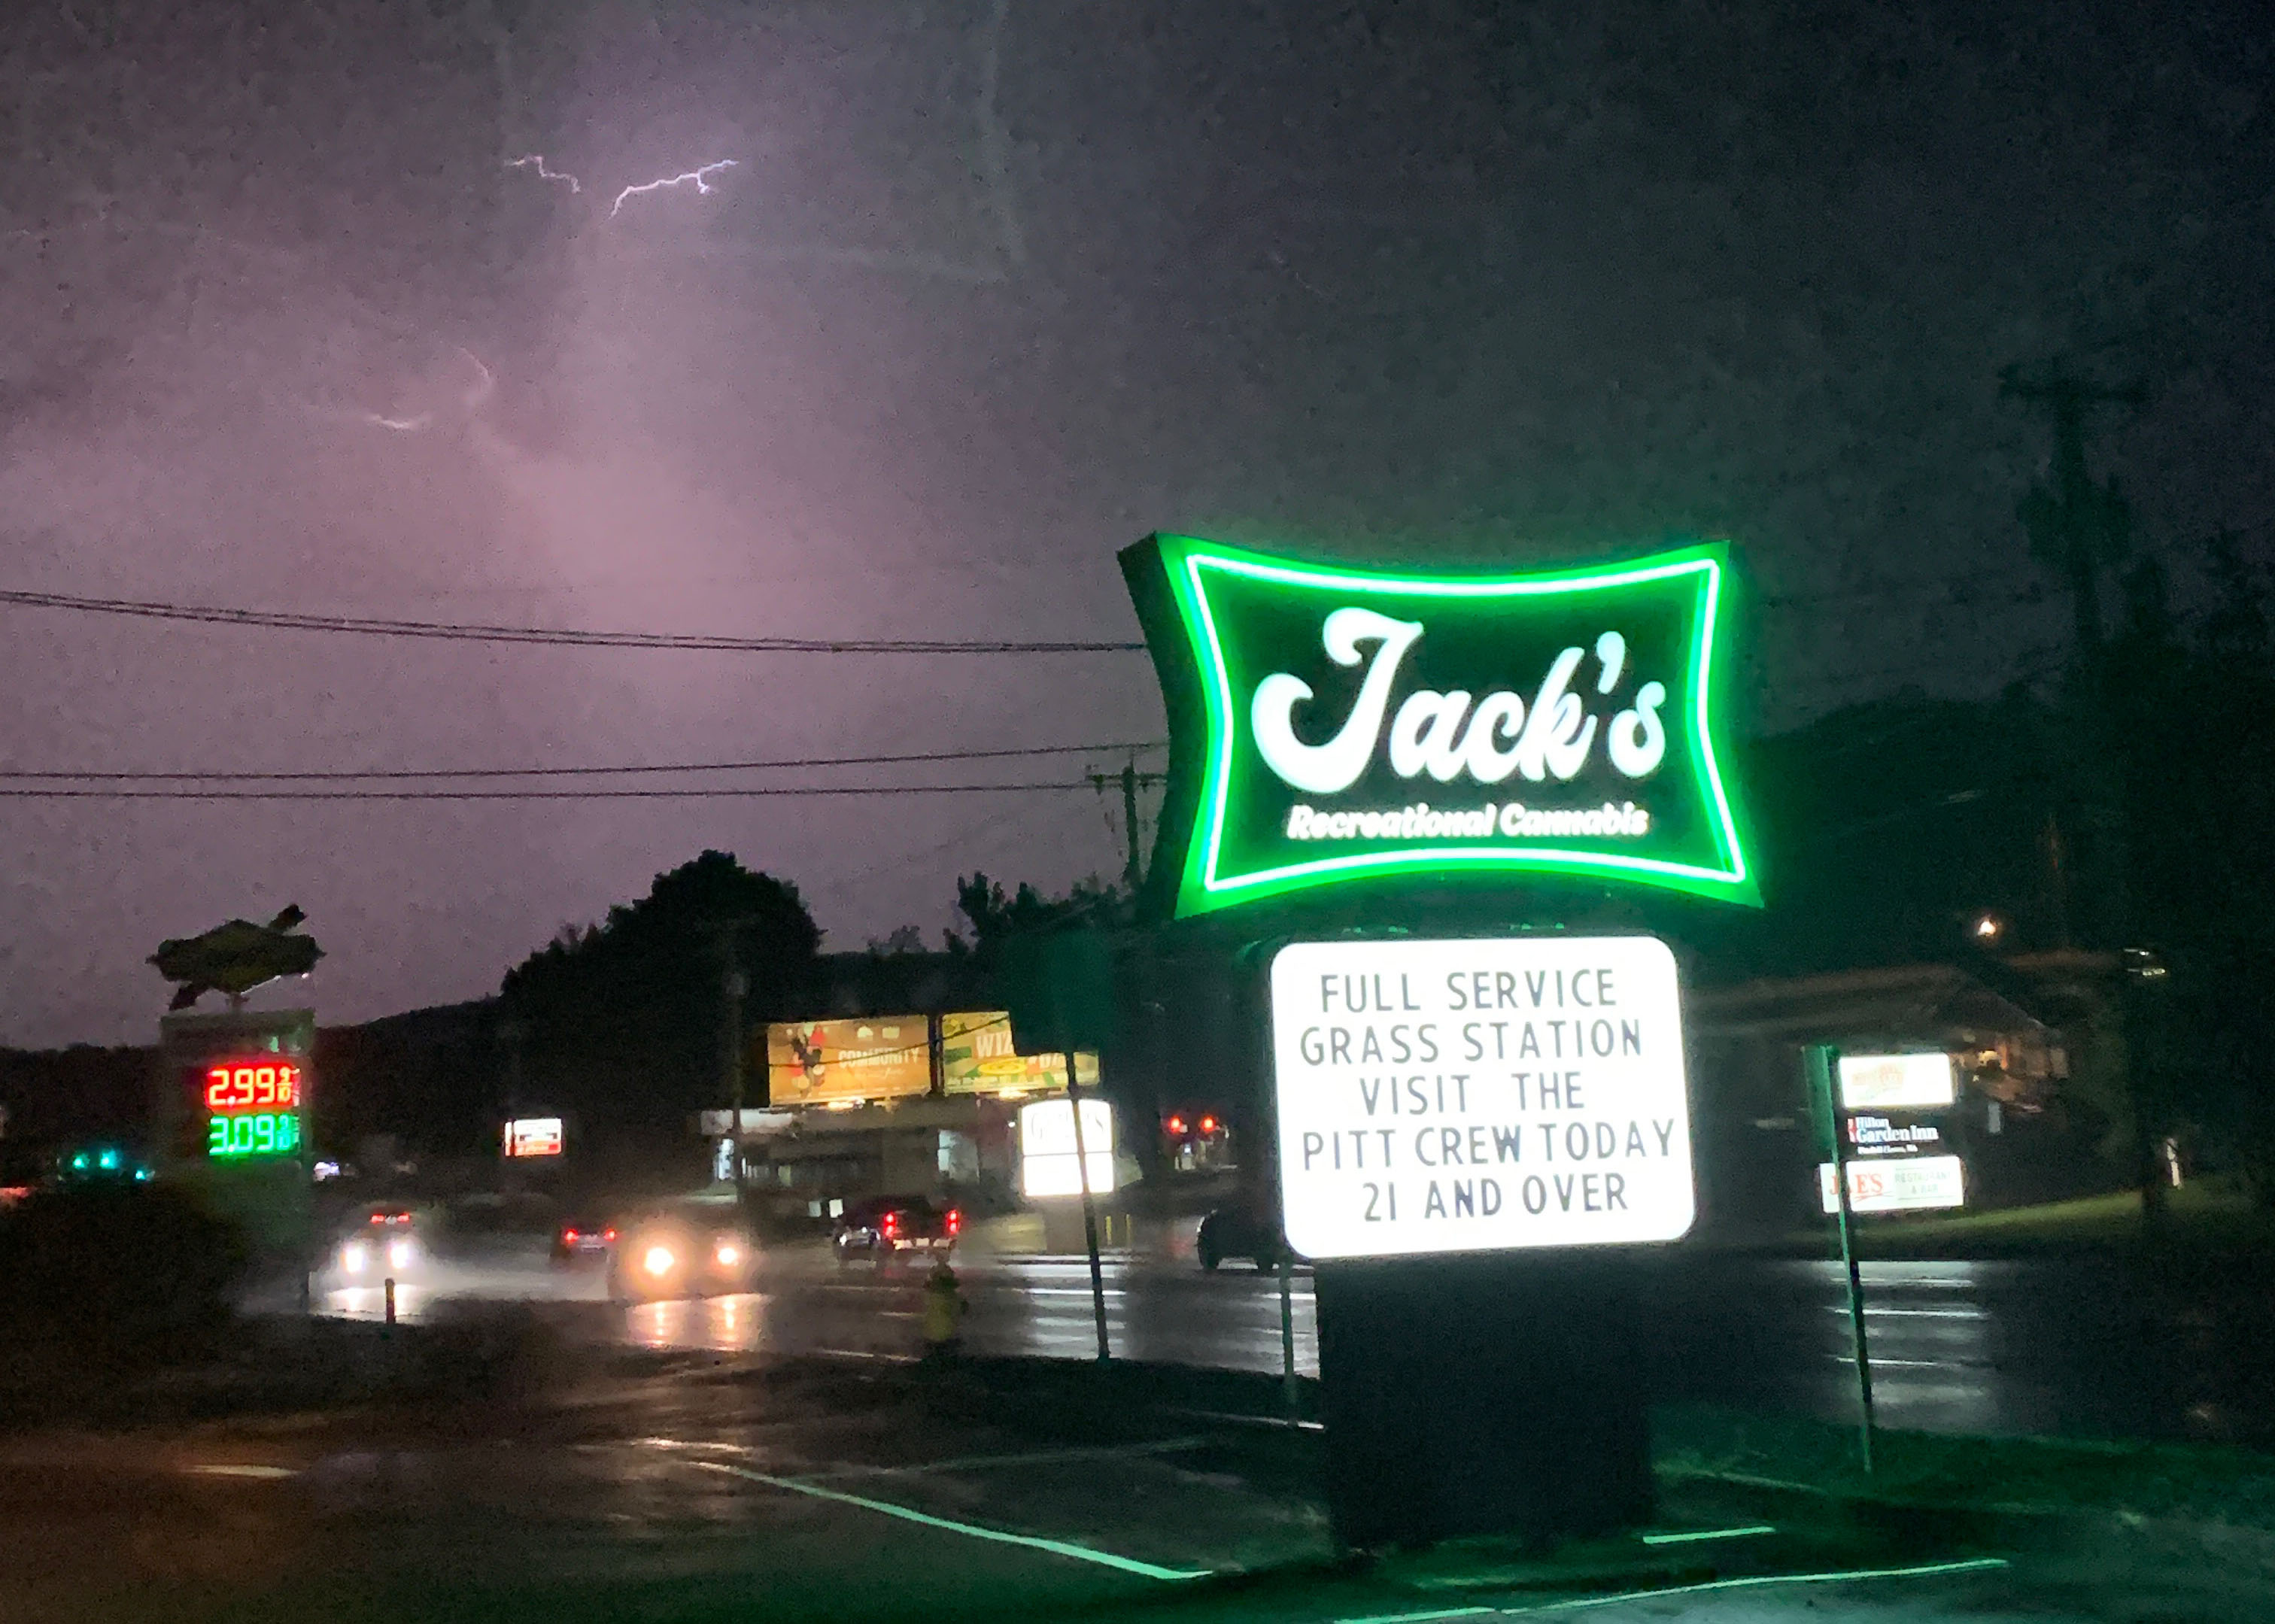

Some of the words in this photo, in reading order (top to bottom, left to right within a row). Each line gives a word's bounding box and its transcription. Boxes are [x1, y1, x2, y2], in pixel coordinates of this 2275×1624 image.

[1250, 606, 1666, 794] Jack's
[1286, 803, 1497, 840] Recreational
[1499, 801, 1650, 837] Cannabis
[1320, 973, 1421, 1013] FULL
[1446, 968, 1617, 1011] SERVICE
[838, 1047, 919, 1068] COMMUNITY
[1299, 1023, 1440, 1067] GRASS
[1462, 1018, 1643, 1062] STATION
[208, 1067, 275, 1106] 2.99
[1359, 1073, 1471, 1116] VISIT
[1511, 1070, 1585, 1111] THE
[208, 1115, 275, 1156] 3.09
[1302, 1128, 1396, 1171] PITT
[1414, 1124, 1522, 1167] CREW
[1537, 1117, 1675, 1163] TODAY
[1856, 1126, 1910, 1143] Garden
[1910, 1124, 1939, 1140] Inn
[1362, 1181, 1397, 1222] 21
[1424, 1177, 1502, 1219] AND
[1522, 1172, 1629, 1215] OVER
[1830, 1173, 1884, 1195] JE'S
